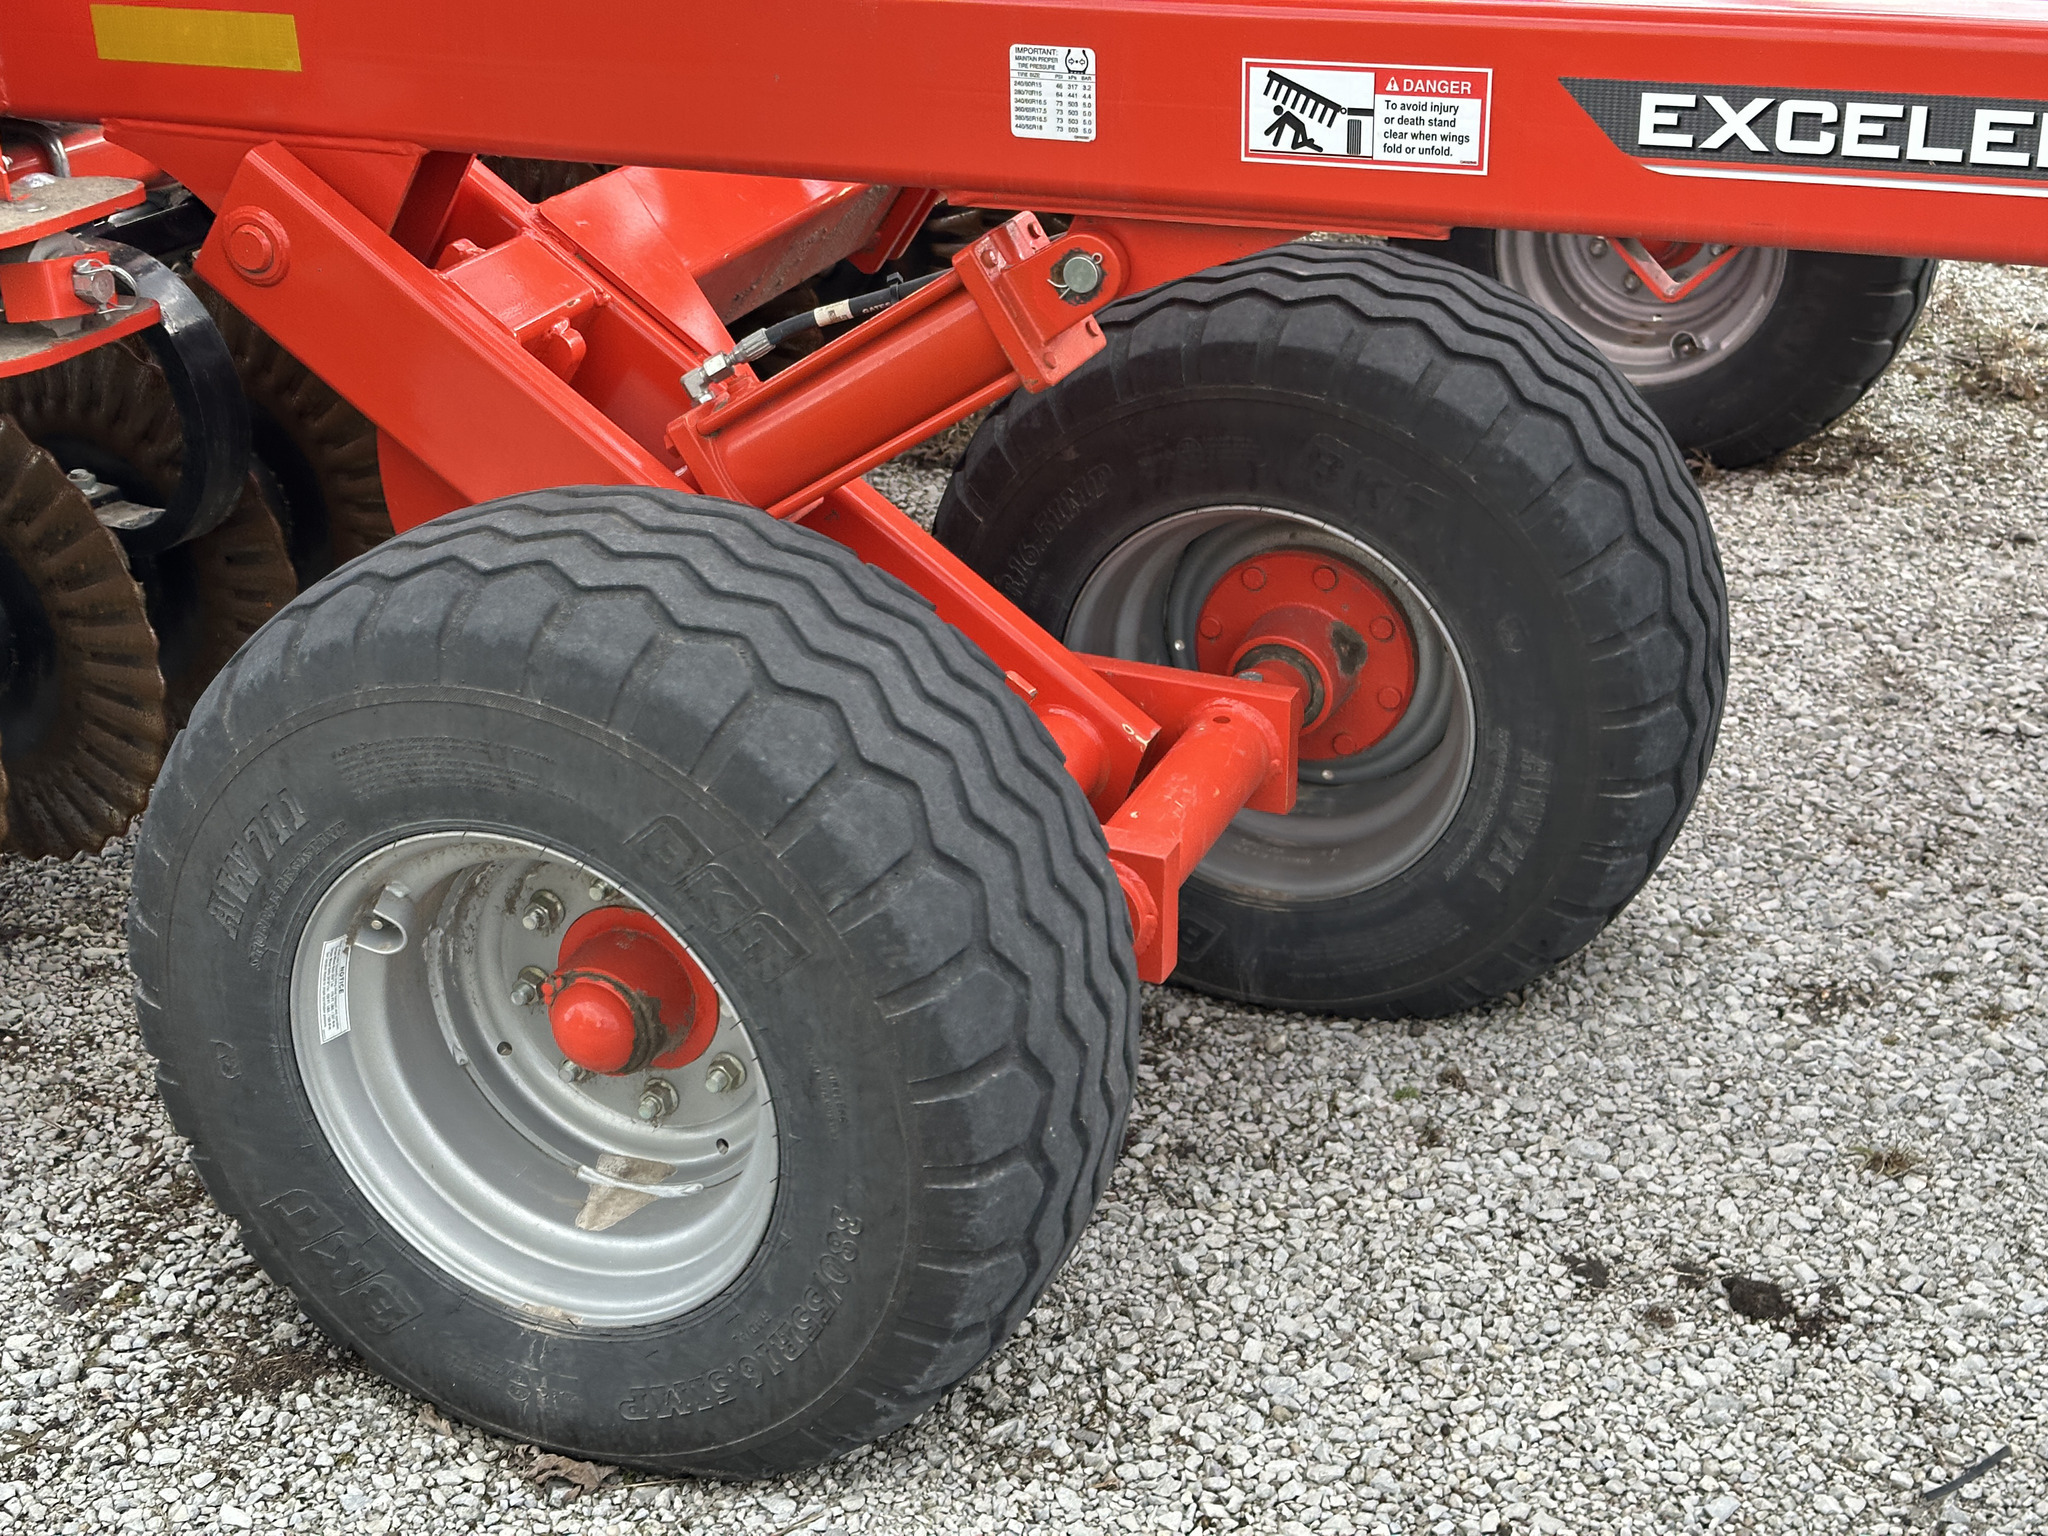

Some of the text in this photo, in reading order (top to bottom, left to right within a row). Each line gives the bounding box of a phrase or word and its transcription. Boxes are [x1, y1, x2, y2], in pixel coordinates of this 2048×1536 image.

[1015, 47, 1058, 56] IMPORTANT:
[1402, 78, 1472, 95] DANGER
[1384, 100, 1459, 115] To avoid injury
[1384, 115, 1456, 128] or death stand
[1383, 130, 1470, 145] clear when wings
[1636, 92, 2048, 168] EXCELE
[1383, 144, 1453, 157] fold or unfold.
[207, 786, 311, 941] AW 711
